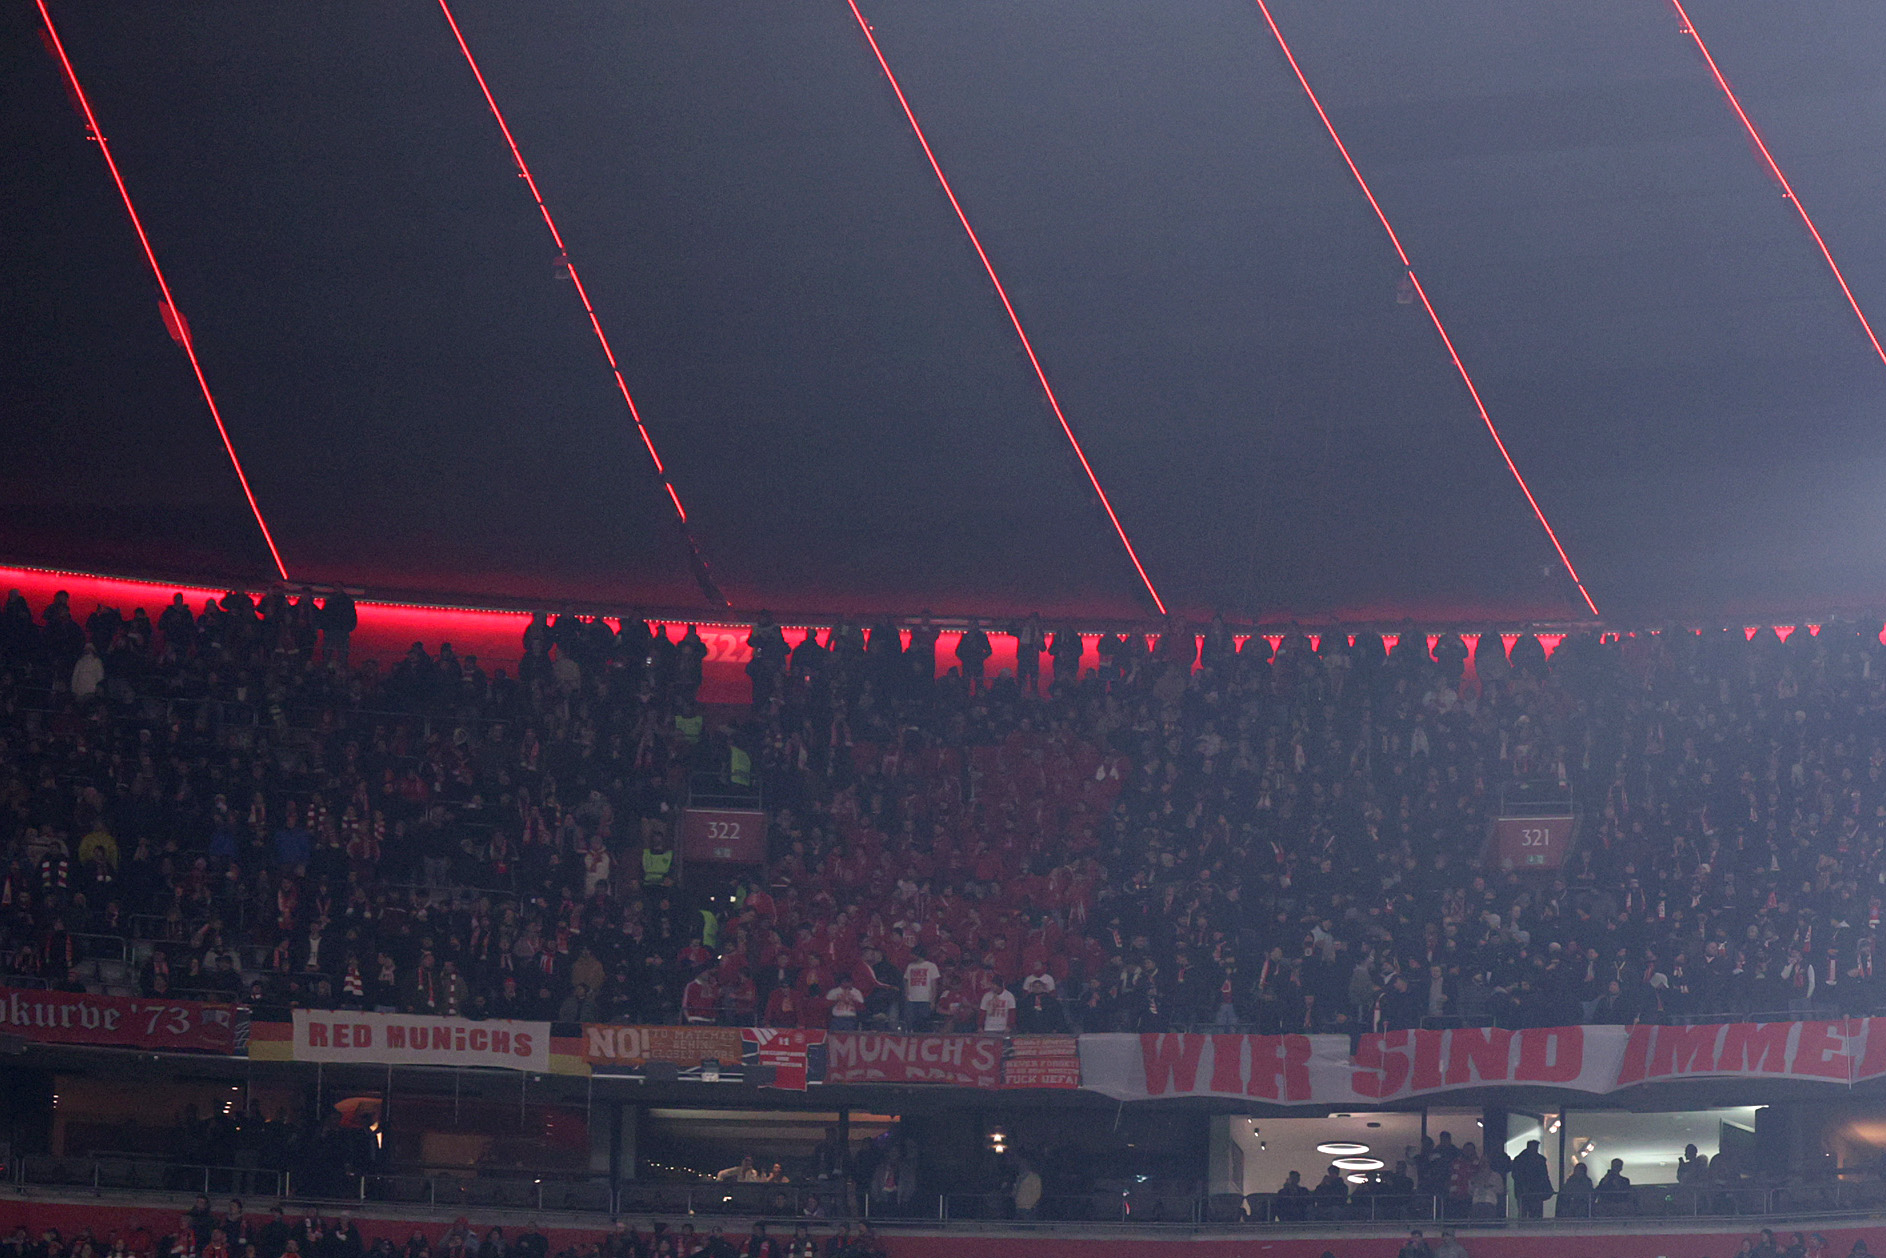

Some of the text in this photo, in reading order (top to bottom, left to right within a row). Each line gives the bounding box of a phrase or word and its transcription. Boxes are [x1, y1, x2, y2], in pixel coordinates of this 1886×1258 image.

[707, 821, 741, 840] 322
[1521, 828, 1550, 847] 321
[0, 992, 191, 1035] kurve '73
[309, 1021, 373, 1049] RED
[586, 1026, 650, 1060] NO!
[1140, 1032, 1311, 1100] WIR
[1350, 1025, 1584, 1097] SIND
[1005, 1075, 1038, 1085] FUCK
